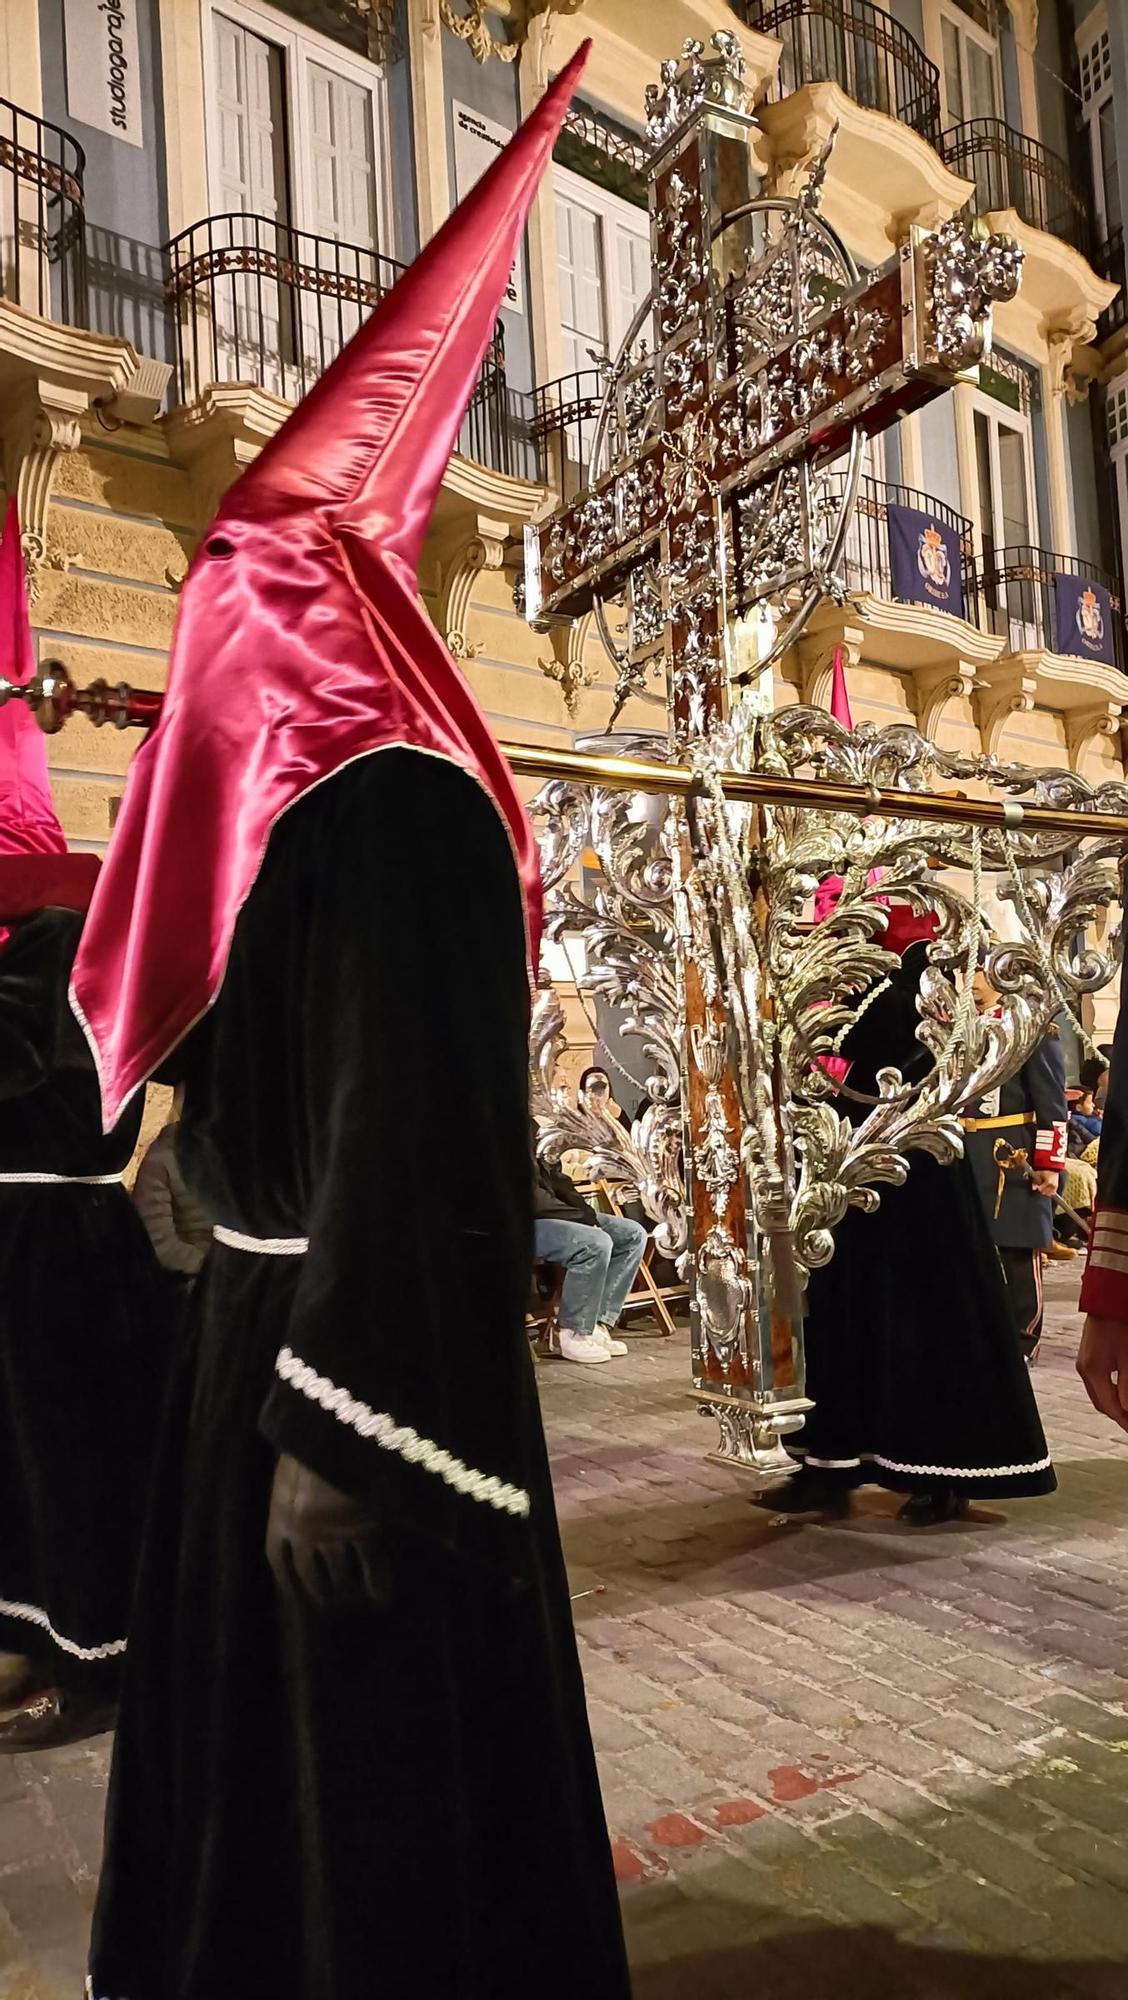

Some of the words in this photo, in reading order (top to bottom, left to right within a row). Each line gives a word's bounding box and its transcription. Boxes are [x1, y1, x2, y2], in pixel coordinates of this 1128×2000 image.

[97, 0, 128, 131] studiogaraje
[458, 111, 486, 131] agencia
[458, 120, 468, 131] de
